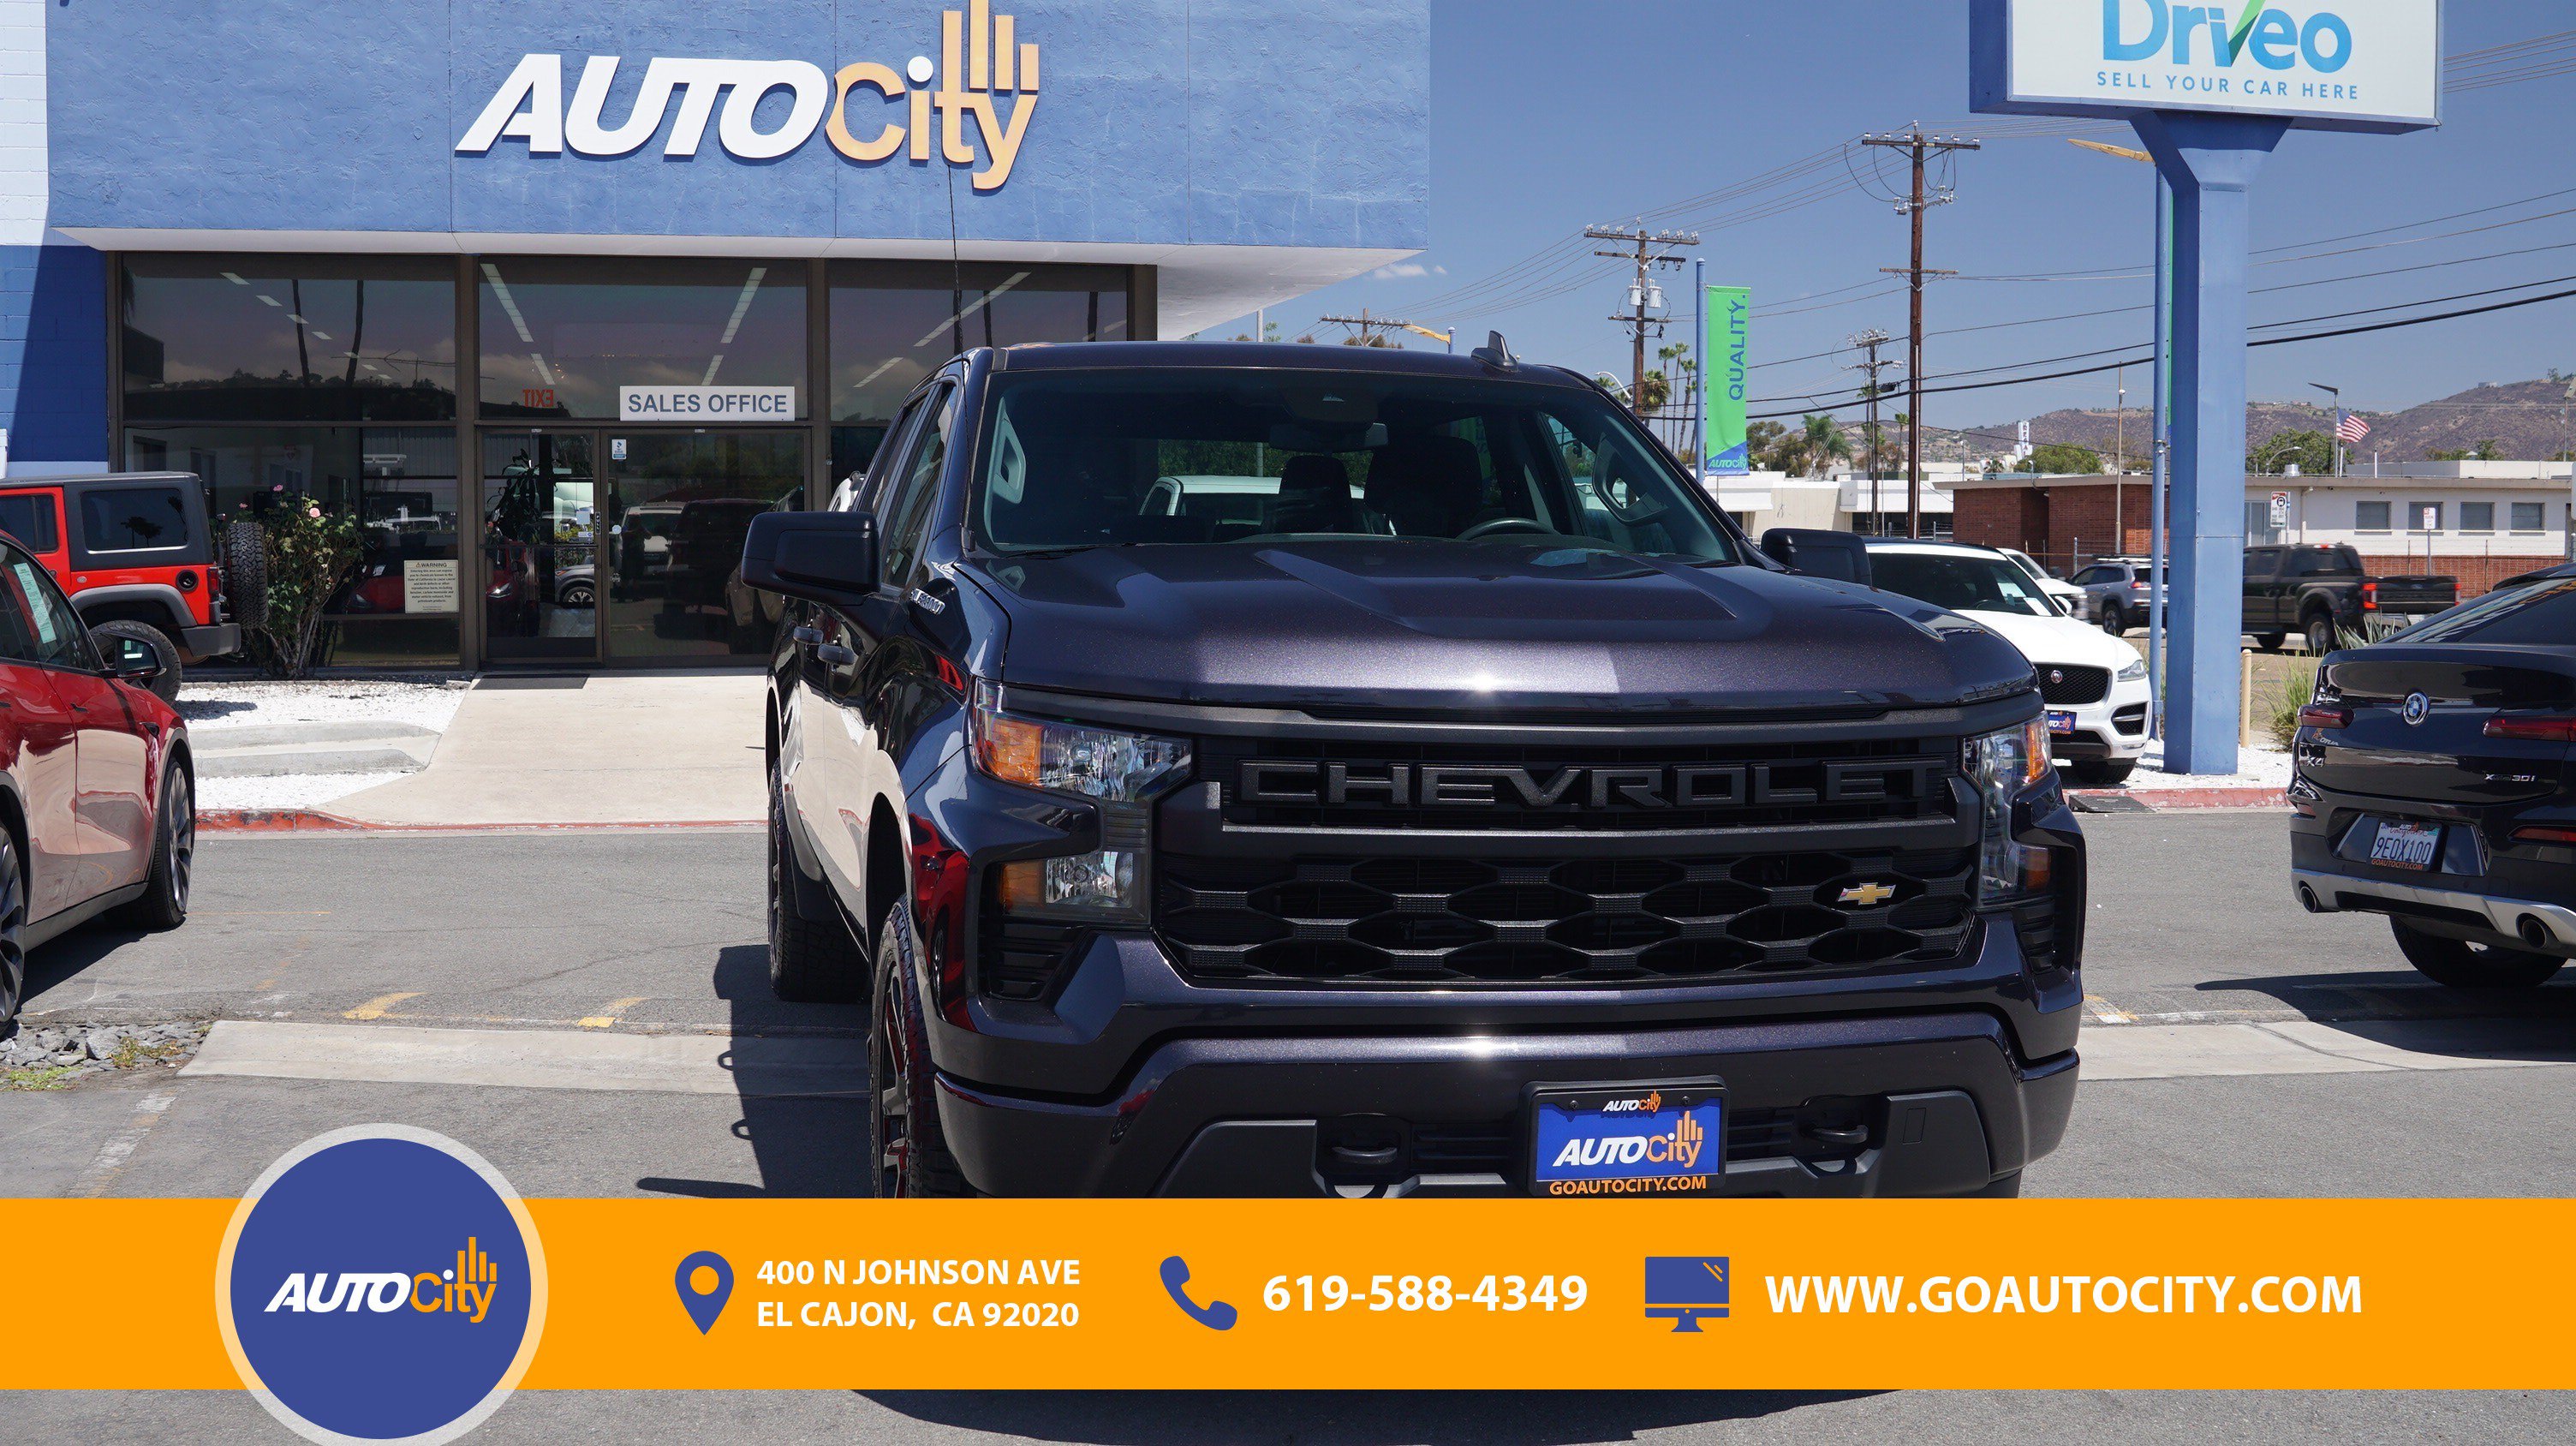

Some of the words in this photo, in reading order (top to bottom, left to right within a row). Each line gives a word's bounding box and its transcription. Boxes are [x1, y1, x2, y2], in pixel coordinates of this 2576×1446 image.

[2103, 0, 2352, 73] Driveo
[2097, 71, 2151, 88] SELL
[2166, 75, 2229, 93] YOUR
[2244, 80, 2288, 96] CAR
[2302, 82, 2358, 99] HERE
[628, 394, 701, 413] SALES
[708, 394, 787, 413] OFFICE
[2306, 756, 2324, 767] X4
[1237, 759, 1947, 810] CHEVROLET
[2371, 858, 2424, 870] GOAUTOCITY.COM
[1549, 1175, 1707, 1196] GOAUTOCITY.COM
